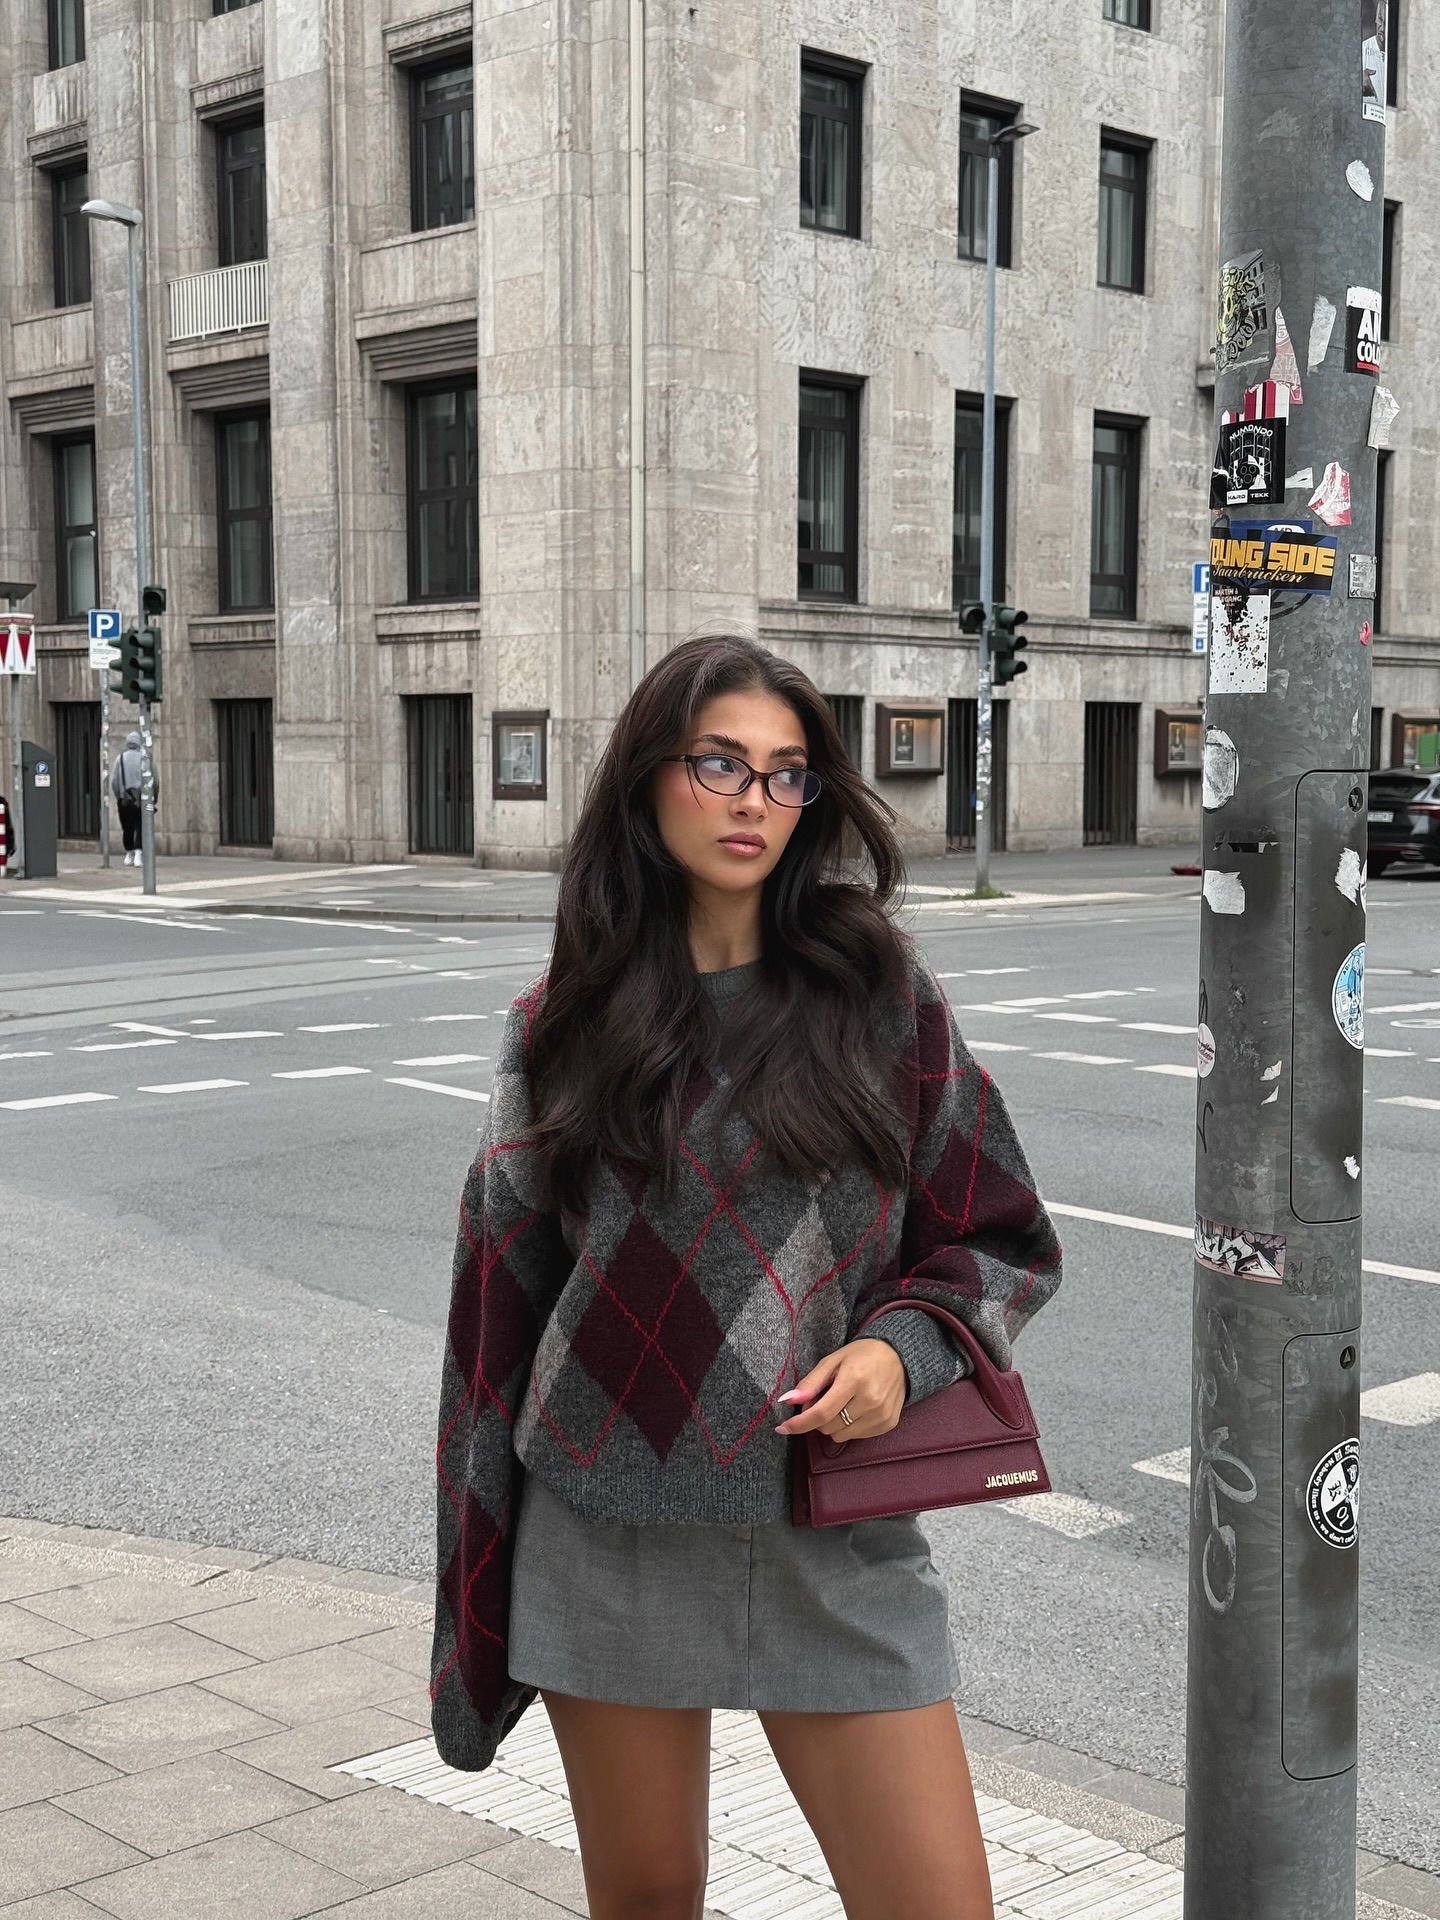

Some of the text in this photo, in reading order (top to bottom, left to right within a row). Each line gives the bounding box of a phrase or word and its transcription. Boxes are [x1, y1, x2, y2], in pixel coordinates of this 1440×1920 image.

[1229, 424, 1273, 441] NUMONDO
[1227, 493, 1246, 501] HARD
[1211, 538, 1336, 577] OUNG SIDE
[1213, 560, 1307, 584] Saarbrücken
[96, 614, 114, 638] P
[985, 1469, 1039, 1489] JACQUEMUS
[1314, 1458, 1335, 1487] Nobody
